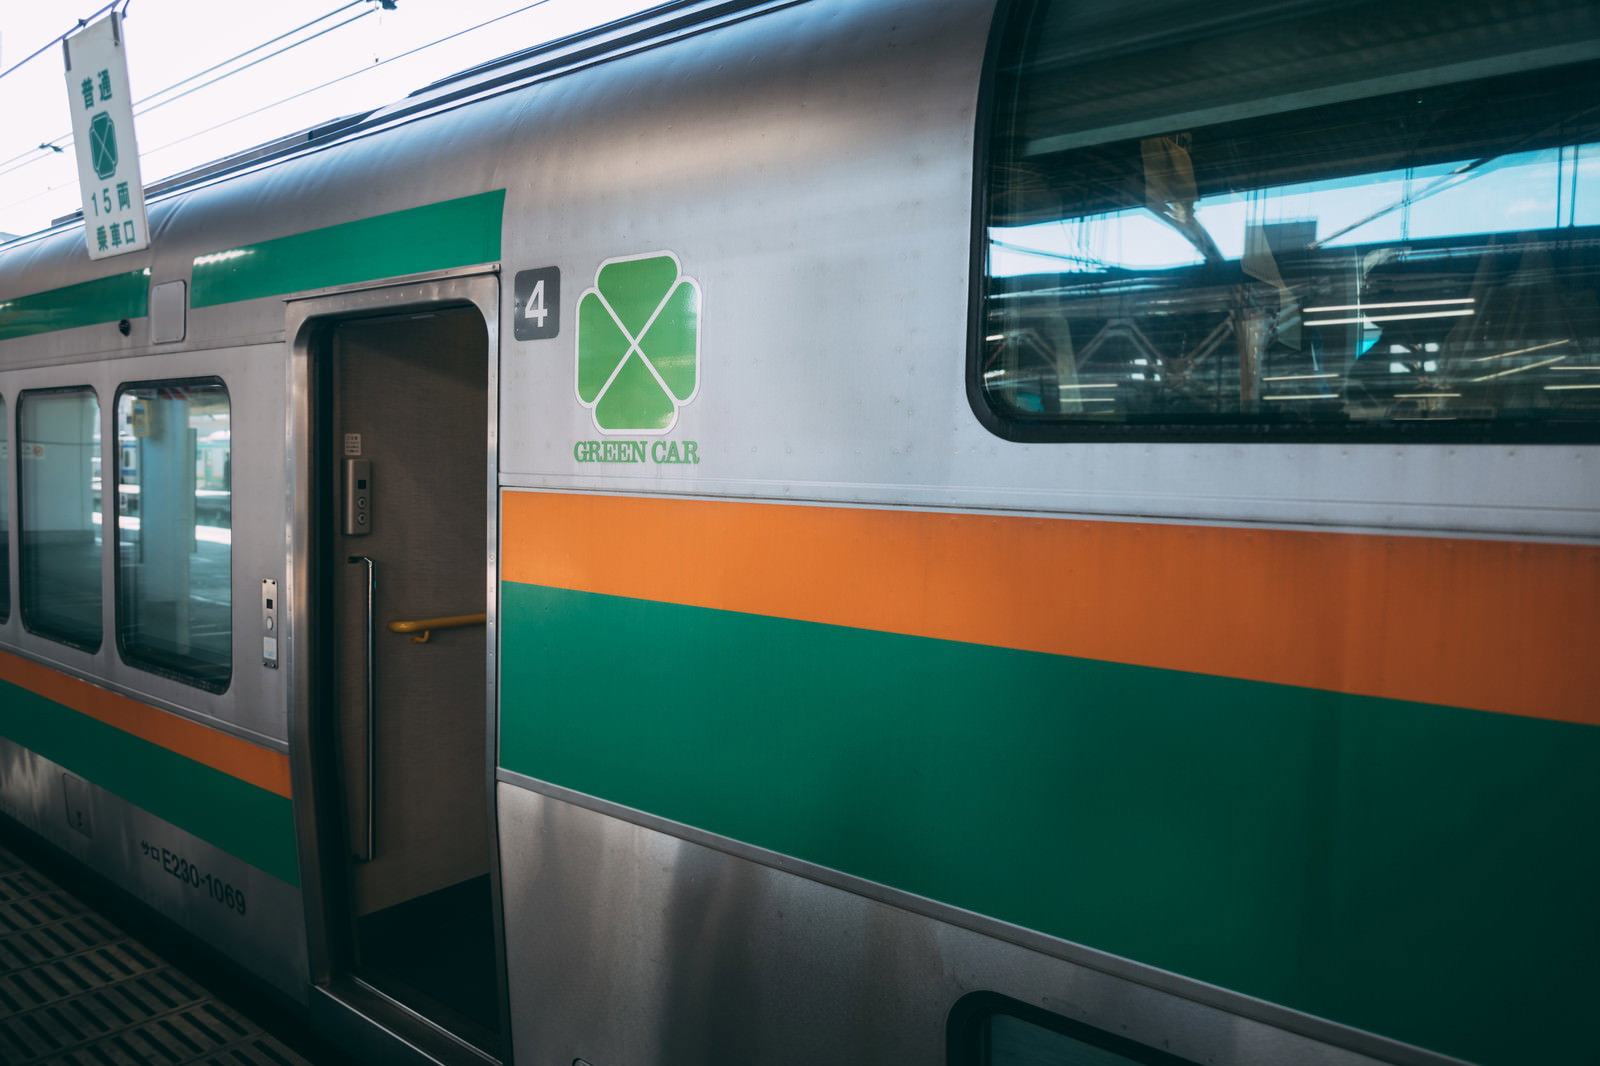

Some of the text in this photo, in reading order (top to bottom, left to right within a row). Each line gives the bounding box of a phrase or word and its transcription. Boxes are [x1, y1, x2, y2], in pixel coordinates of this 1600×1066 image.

[81, 69, 113, 110] 普通
[91, 181, 131, 217] 15両
[96, 219, 135, 252] 乗車口
[524, 279, 548, 328] 4
[573, 440, 700, 464] GREEN CAR
